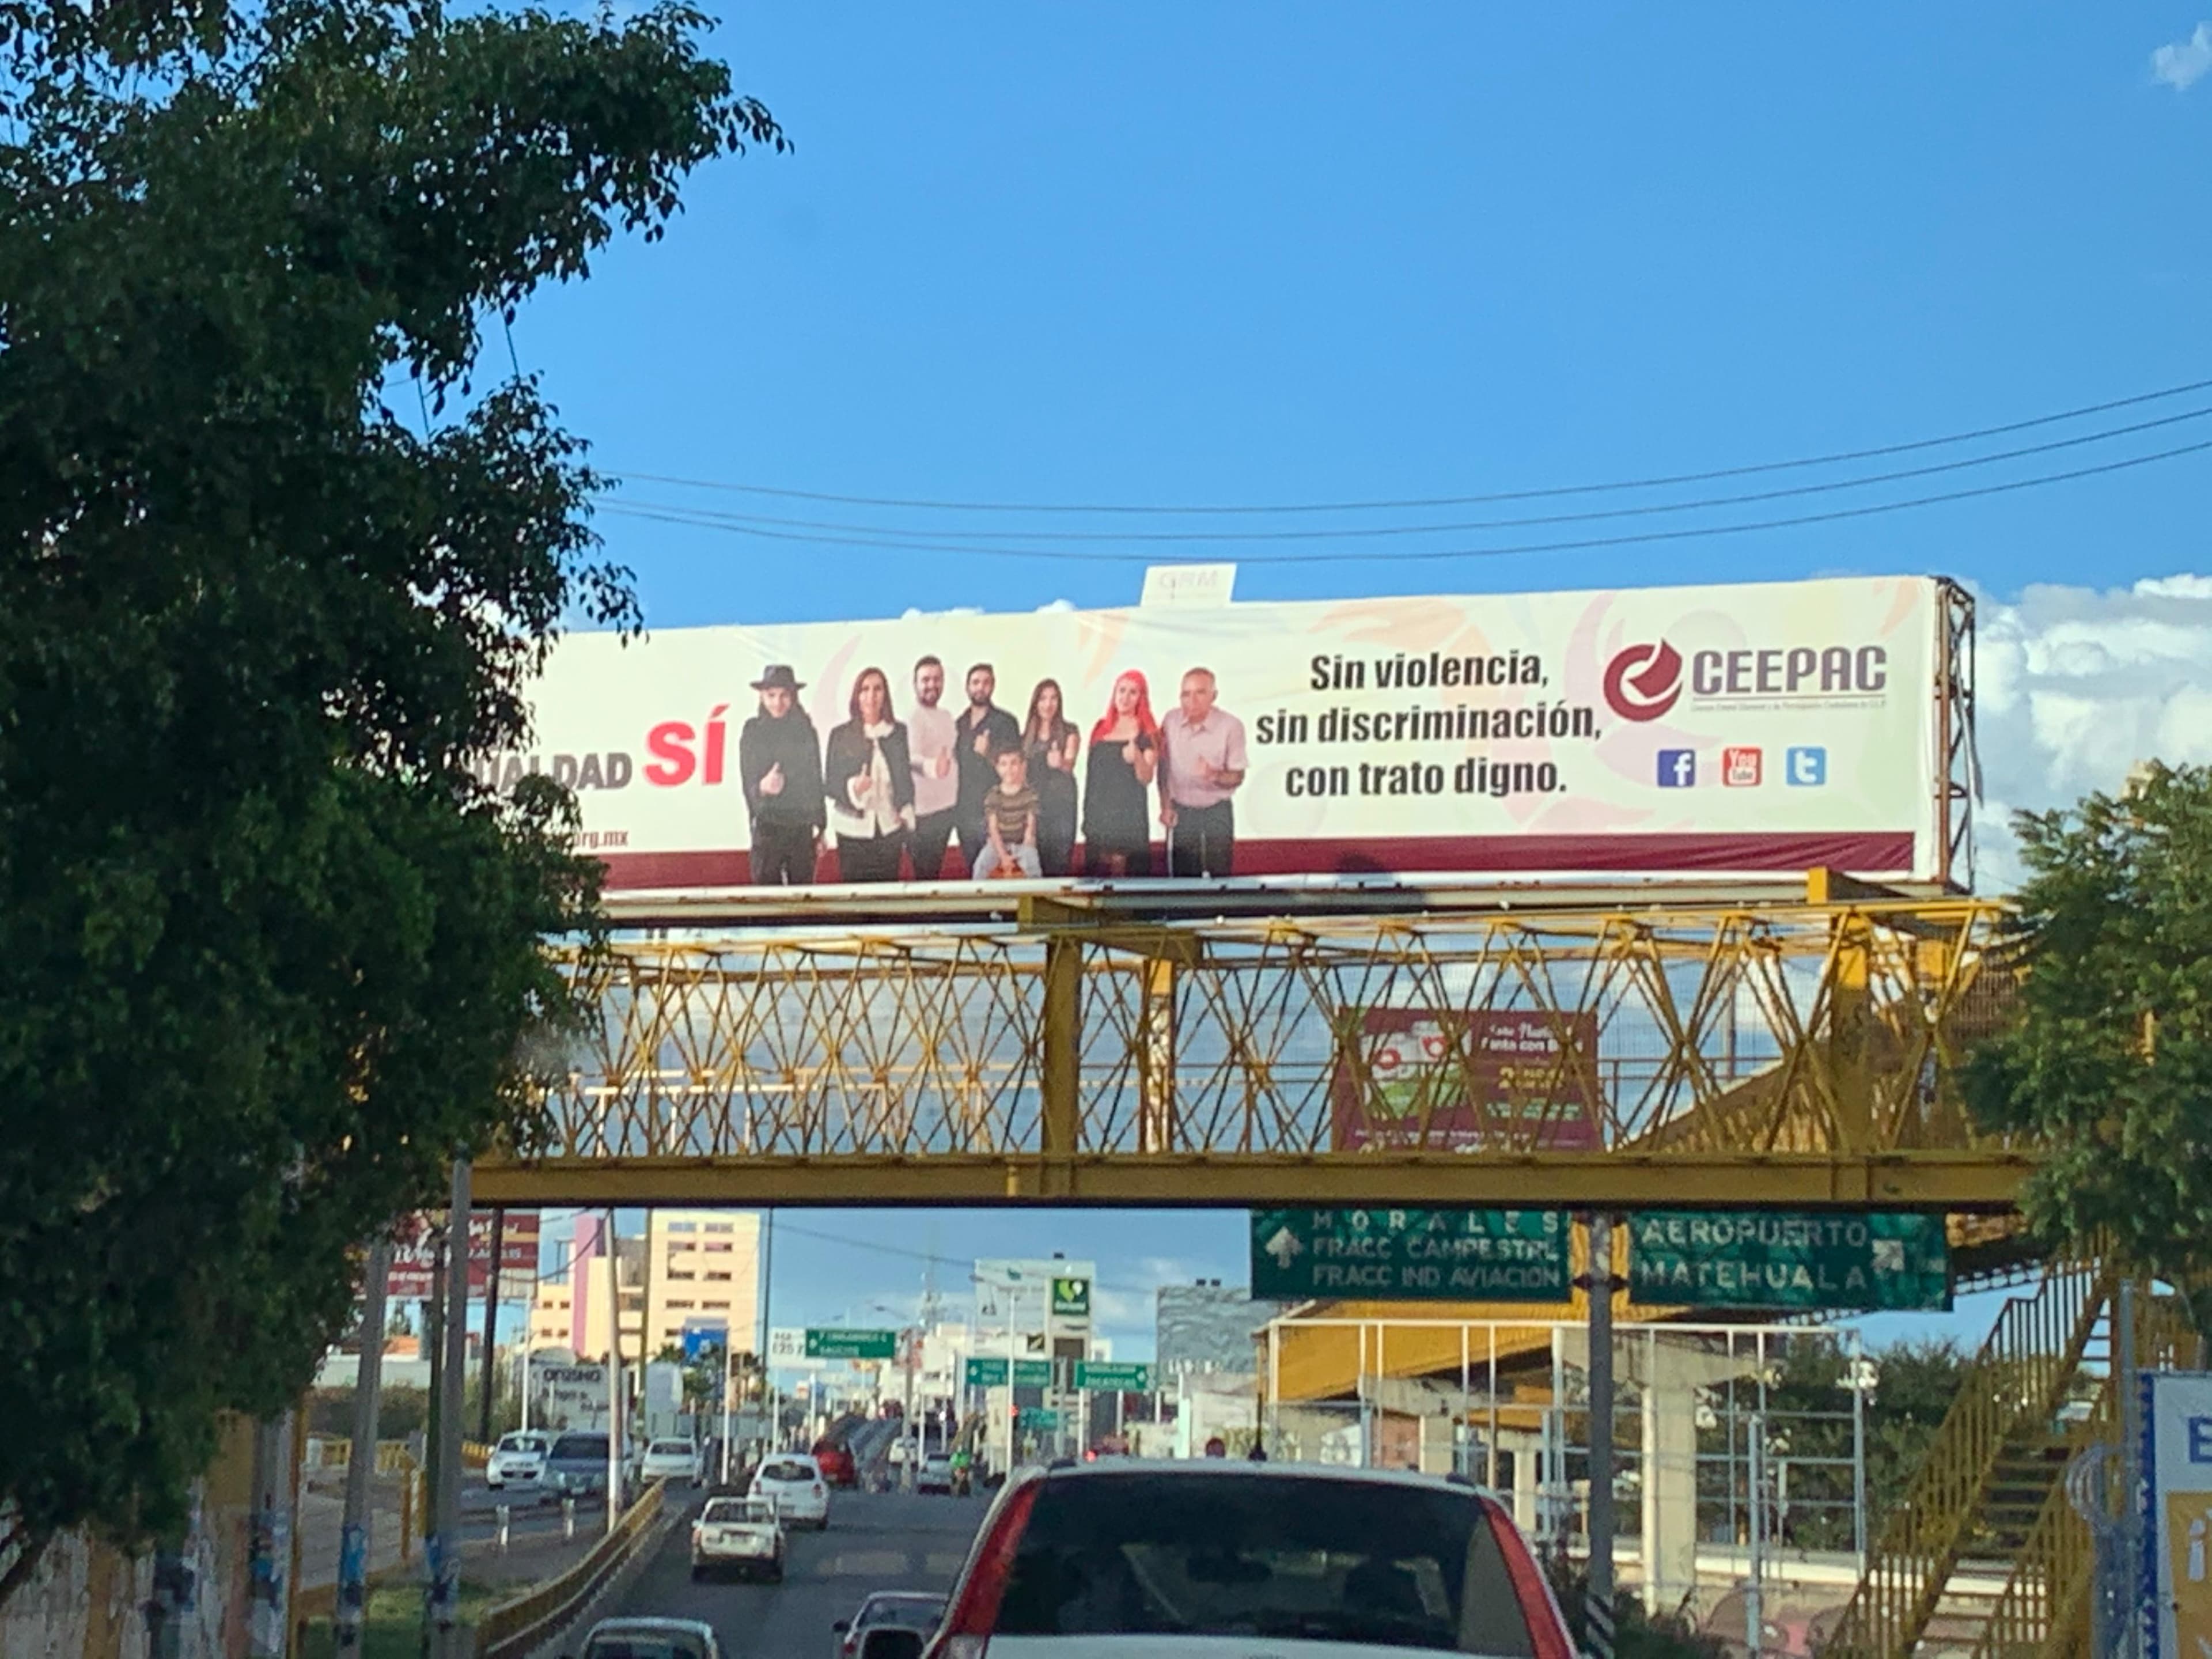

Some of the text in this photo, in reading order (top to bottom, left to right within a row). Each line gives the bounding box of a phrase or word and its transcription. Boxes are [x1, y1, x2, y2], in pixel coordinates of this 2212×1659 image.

[1310, 650, 1549, 691] Sin violencia,
[1692, 646, 1887, 695] CEEPAC
[1256, 700, 1602, 744] sin discriminación,
[642, 704, 730, 787] SÍ
[1729, 749, 1756, 767] You
[1286, 757, 1567, 798] con trato digno.
[1732, 770, 1753, 781] Tube
[1313, 1210, 1559, 1233] MORALES
[1641, 1218, 1868, 1247] AEROPUERTO
[1313, 1236, 1392, 1260] FRACC
[1313, 1264, 1393, 1288] FRACC
[1402, 1266, 1441, 1288] IND
[1641, 1260, 1868, 1291] MATEHUALA
